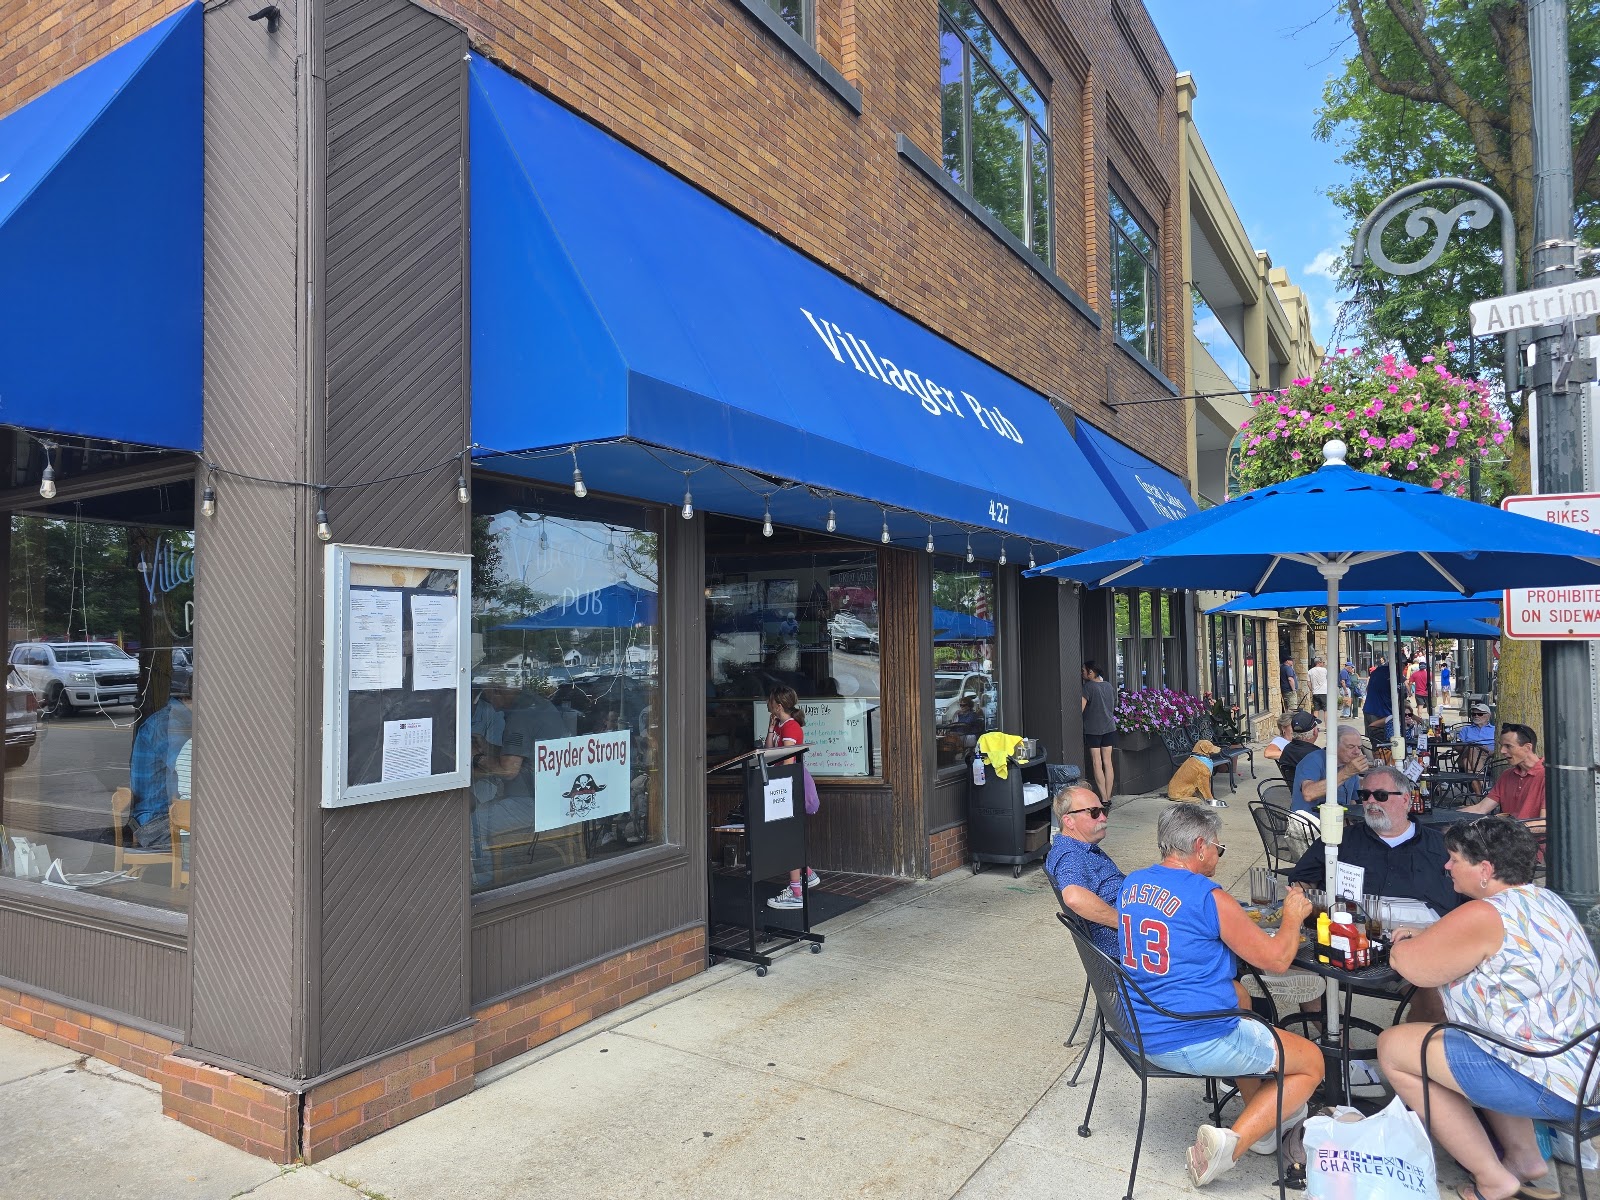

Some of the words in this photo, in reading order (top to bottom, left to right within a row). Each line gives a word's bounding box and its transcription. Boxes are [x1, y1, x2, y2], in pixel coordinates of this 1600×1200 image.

[1487, 288, 1598, 331] Antrim
[799, 307, 965, 419] Villager
[960, 390, 1024, 445] Pub
[988, 499, 1009, 525] 427
[1546, 509, 1590, 524] BIKES
[560, 586, 604, 617] PUB
[1521, 609, 1541, 623] ON
[537, 741, 585, 777] Rayder
[587, 738, 627, 766] Strong
[1121, 883, 1182, 918] CASTRO
[1121, 913, 1170, 976] 13
[1319, 1159, 1427, 1190] CHARLEVOIX
